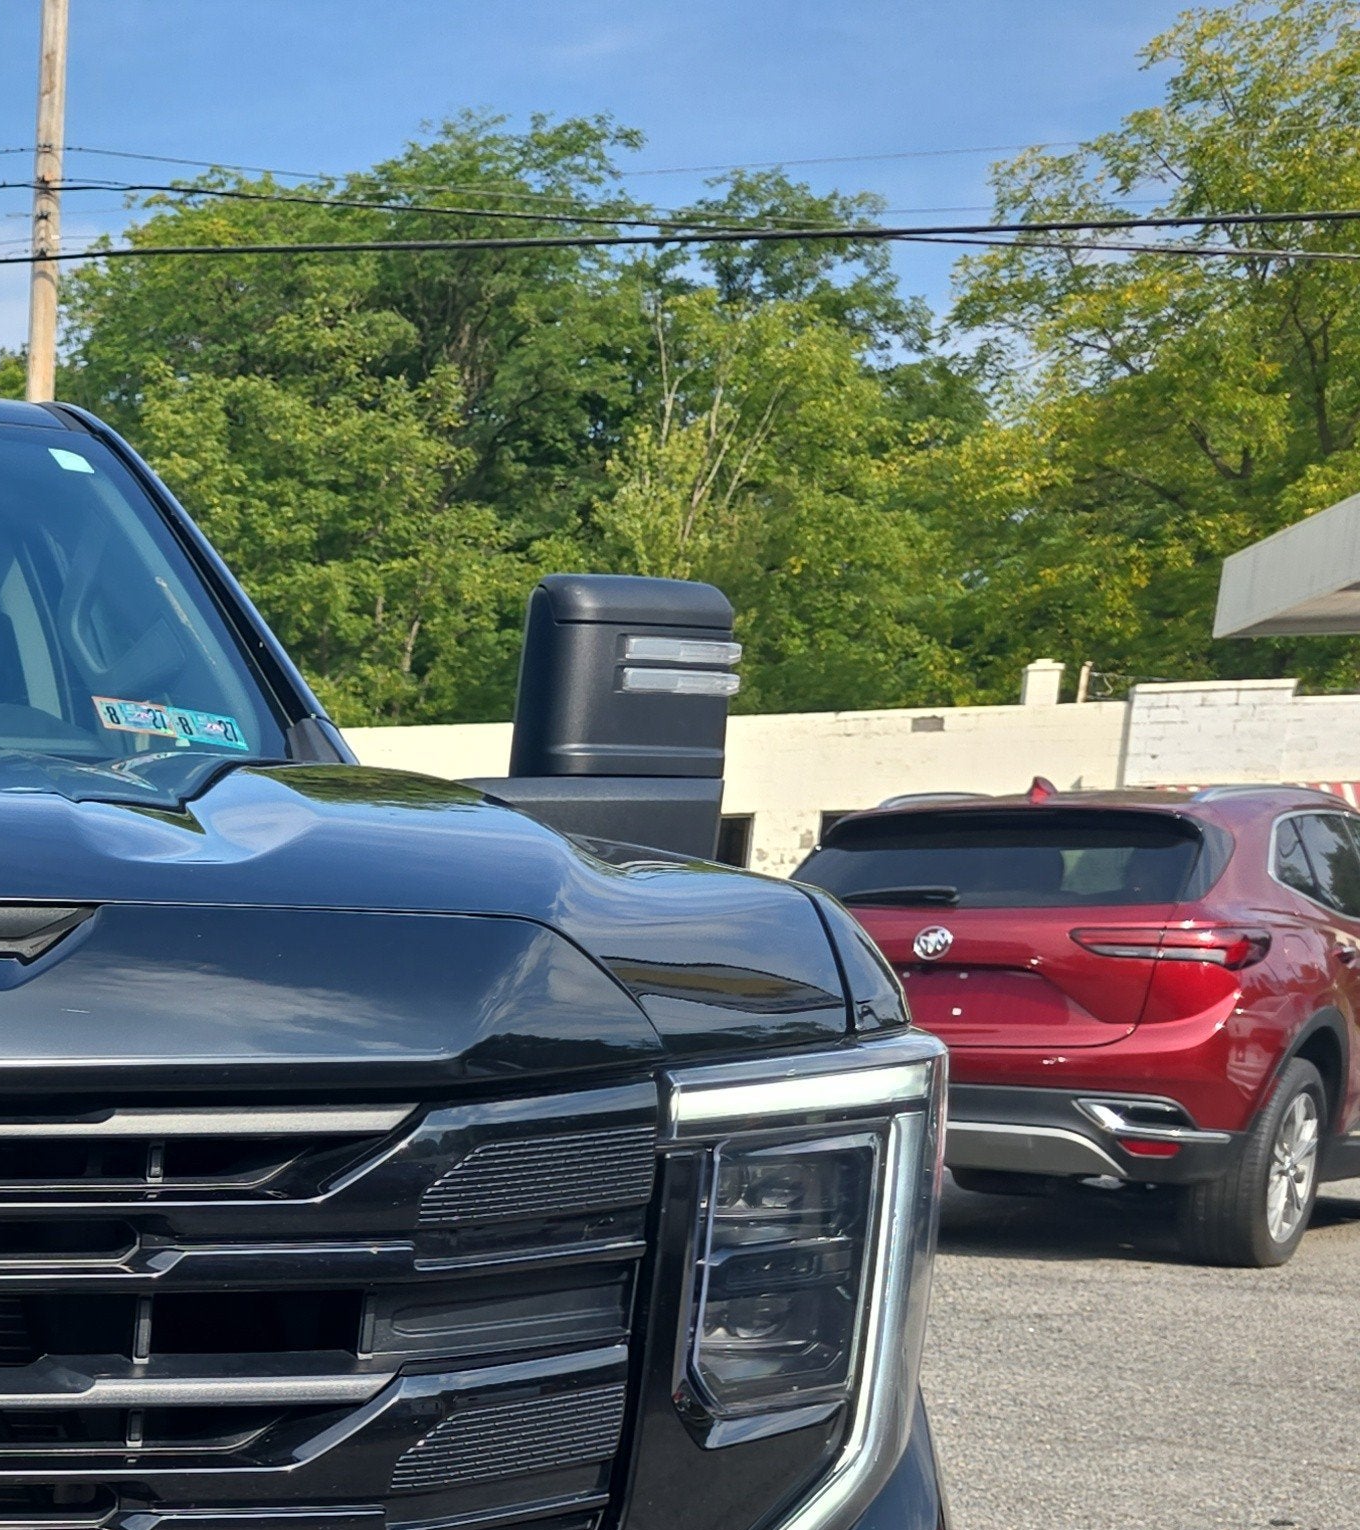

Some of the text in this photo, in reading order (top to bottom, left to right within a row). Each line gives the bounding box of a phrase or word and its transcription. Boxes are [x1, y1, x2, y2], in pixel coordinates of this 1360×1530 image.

[105, 705, 239, 743] 8 27 8 27
